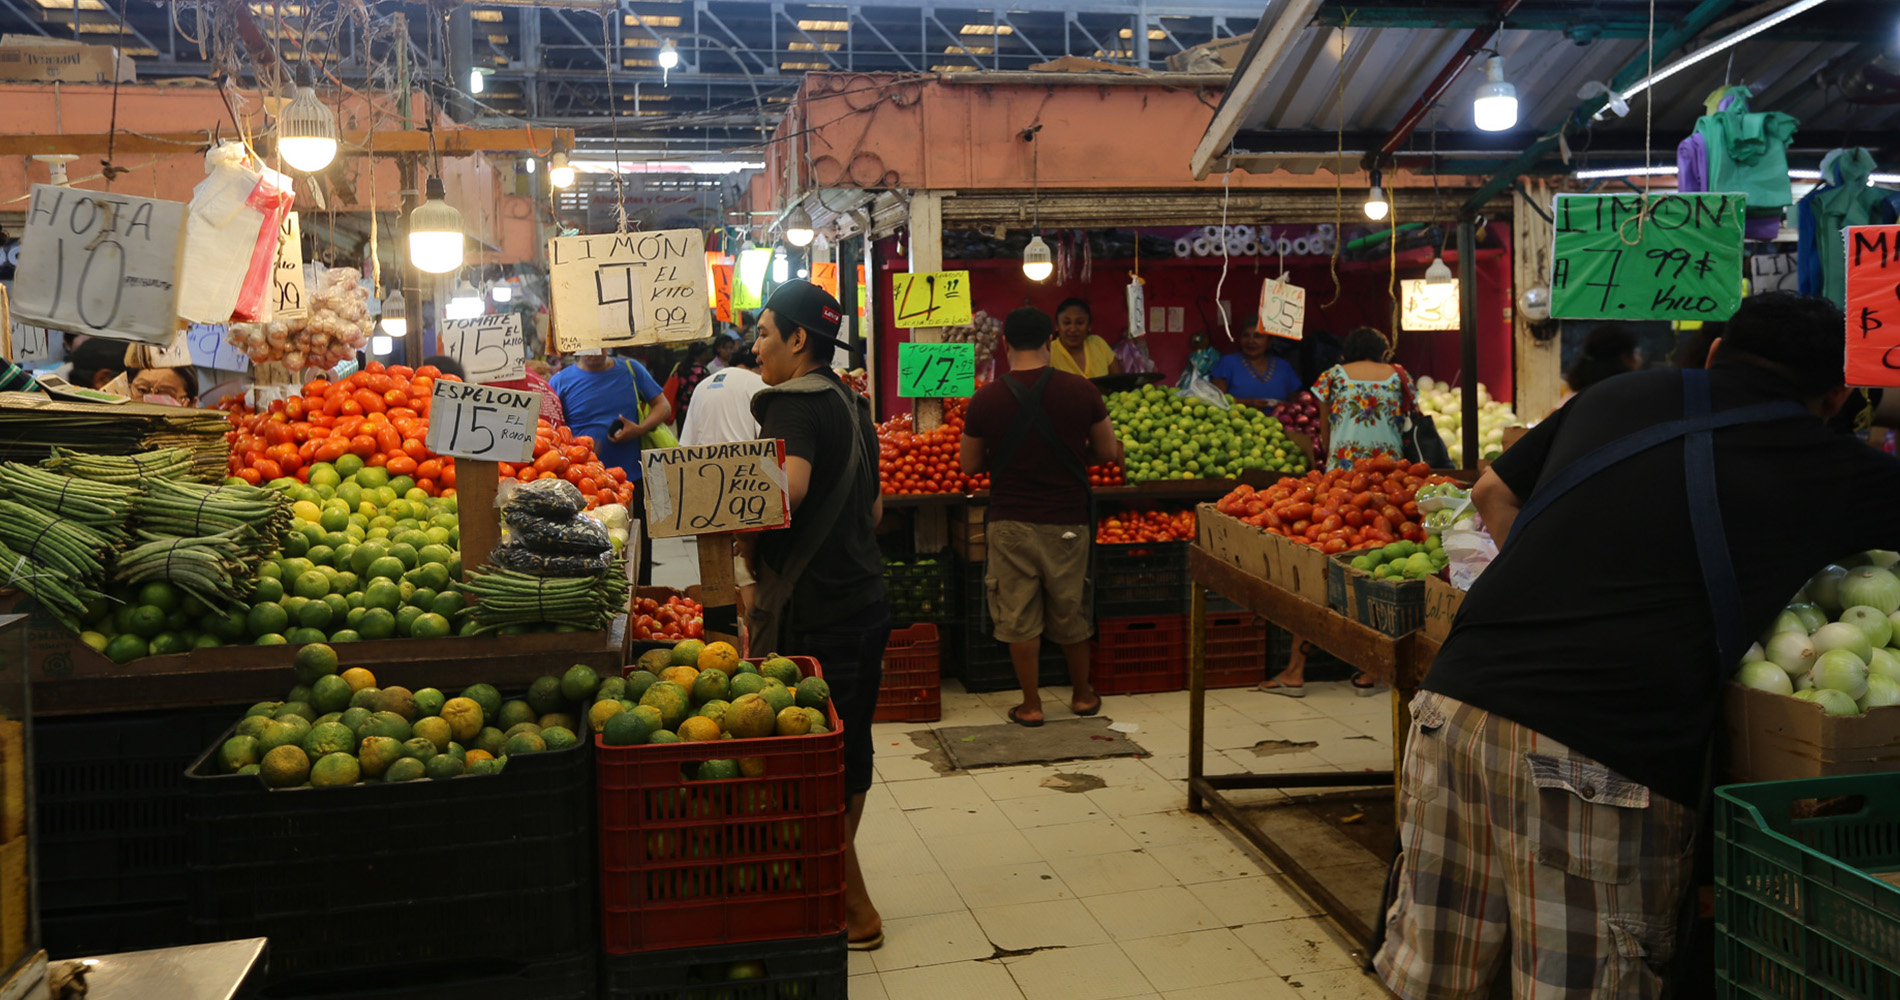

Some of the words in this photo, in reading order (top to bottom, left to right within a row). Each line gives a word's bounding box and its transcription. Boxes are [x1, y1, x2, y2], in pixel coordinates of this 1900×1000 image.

[554, 233, 687, 265] LIMÓN
[47, 238, 125, 330] 10
[654, 266, 677, 282] EL
[594, 263, 645, 341] 4
[443, 314, 510, 330] TOMATE
[655, 306, 687, 326] 99
[505, 325, 520, 336] EL
[909, 344, 968, 357] TOMATE
[449, 402, 497, 454] 15
[505, 414, 524, 425] EL
[648, 441, 777, 468] MANDARINA
[734, 463, 758, 477] EL
[728, 478, 770, 494] KILO
[675, 463, 726, 530] 12
[729, 495, 766, 520] 99
